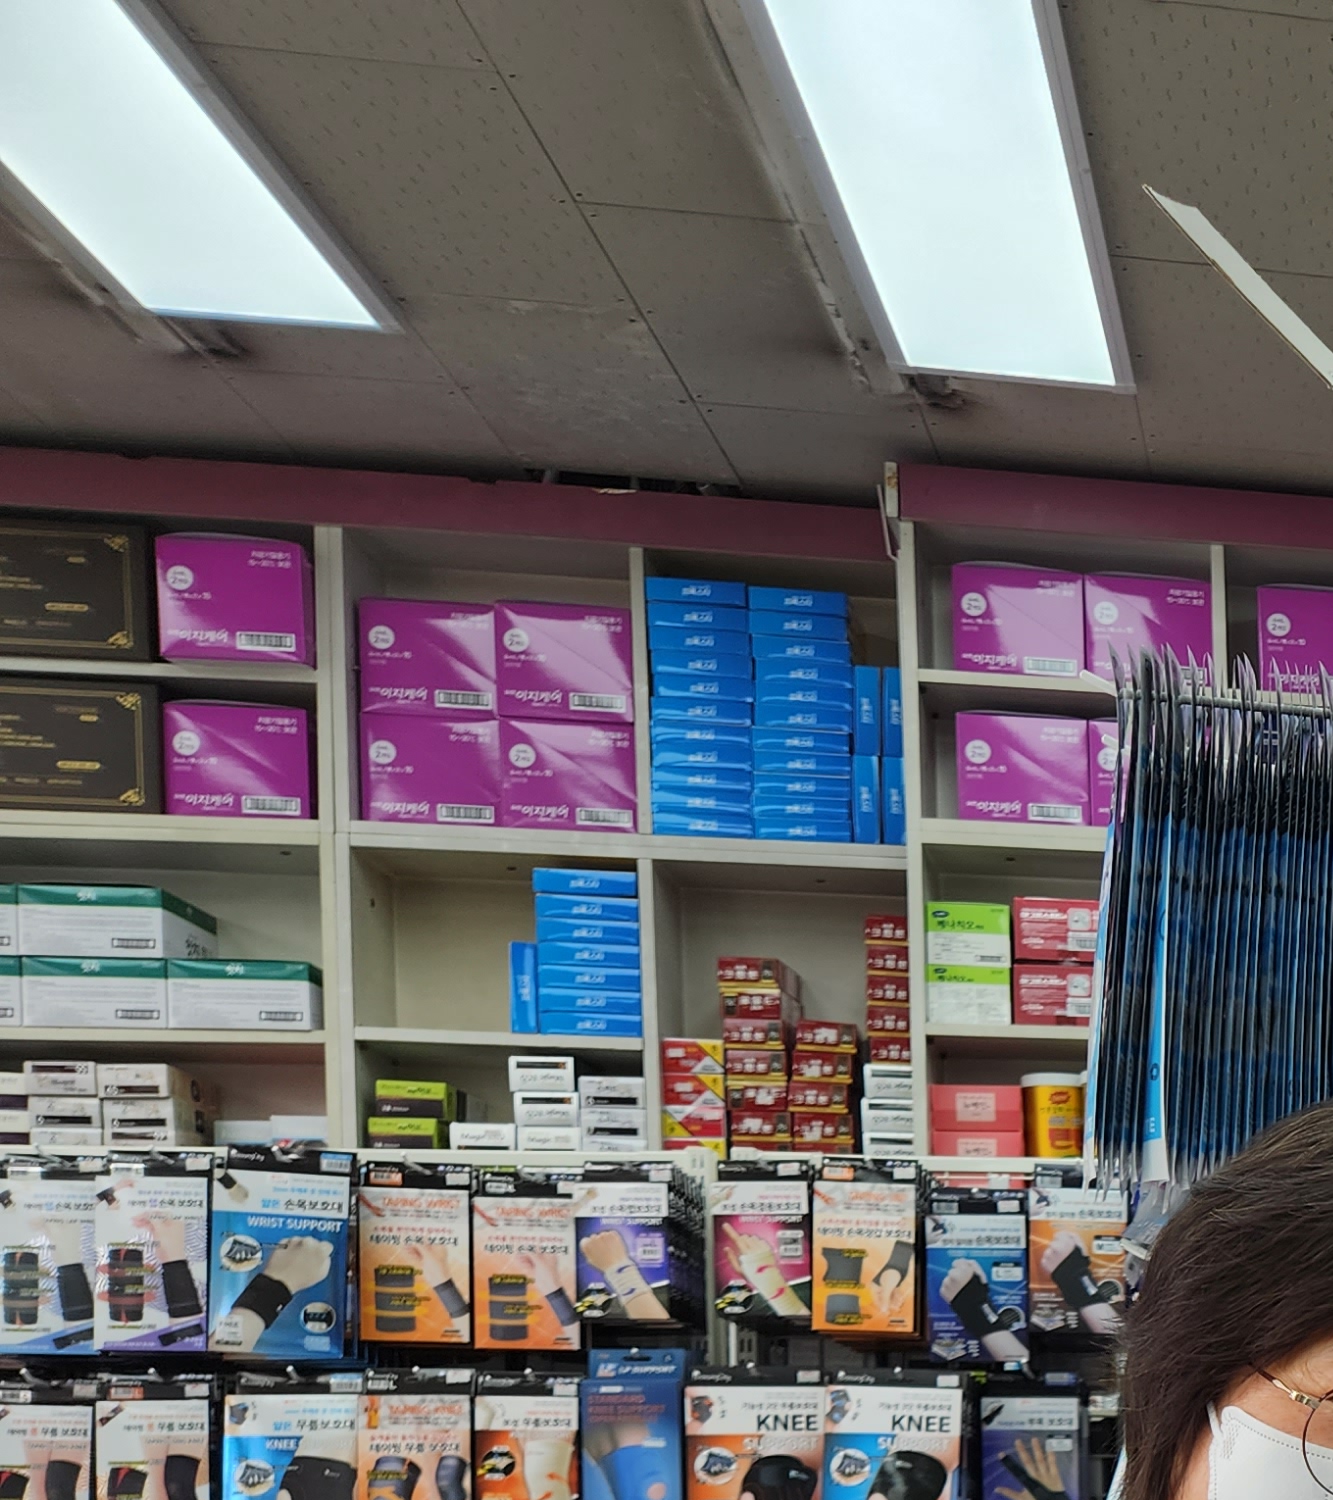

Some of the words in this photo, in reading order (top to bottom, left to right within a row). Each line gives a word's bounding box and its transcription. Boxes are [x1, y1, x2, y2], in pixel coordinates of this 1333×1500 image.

[248, 1216, 284, 1229] WRIST
[286, 1219, 343, 1232] SUPPORT
[757, 1415, 819, 1431] KNEE
[891, 1415, 952, 1432] KNEE
[266, 1439, 298, 1449] KNEE
[743, 1438, 819, 1450] SUPPORT
[878, 1438, 949, 1450] SUPPORT
